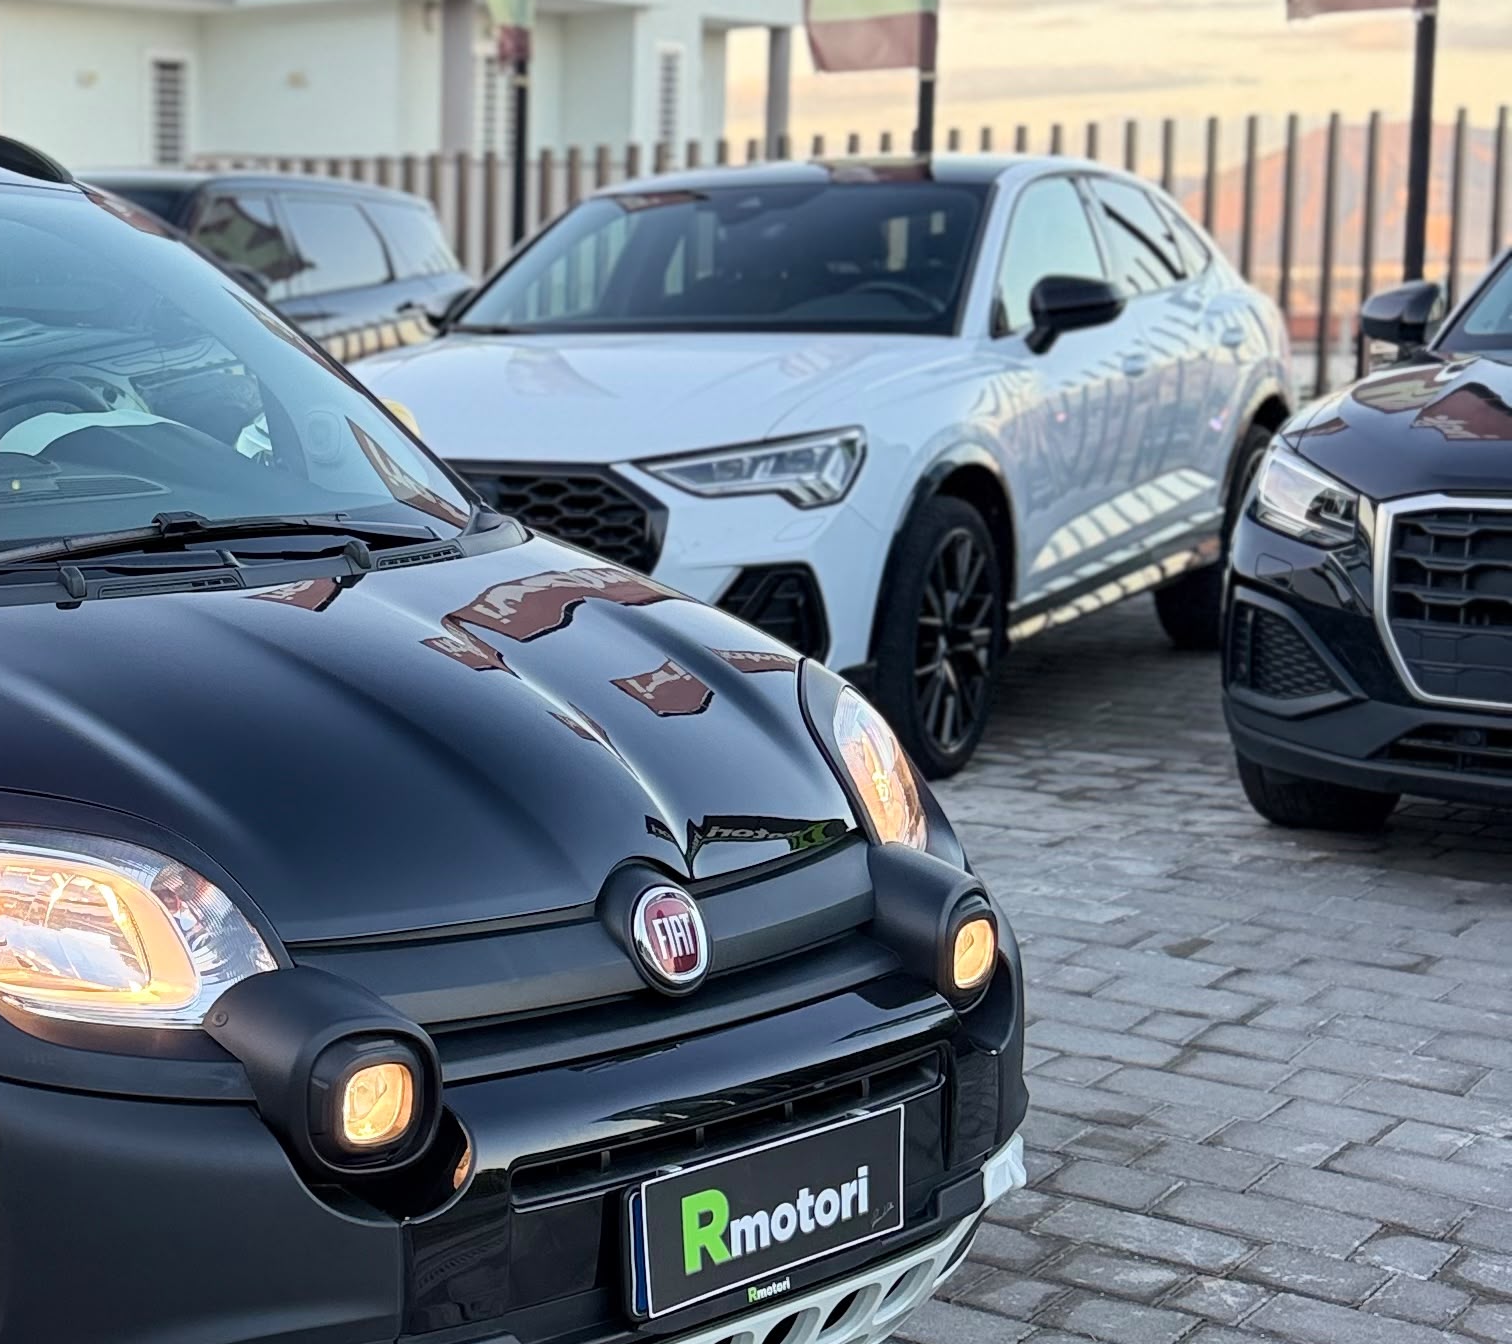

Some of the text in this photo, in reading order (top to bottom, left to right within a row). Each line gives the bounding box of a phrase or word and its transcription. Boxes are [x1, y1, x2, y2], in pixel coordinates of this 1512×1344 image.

[652, 912, 696, 960] FIAT
[681, 1165, 869, 1276] Rmotori
[748, 1276, 791, 1303] Rmotori
